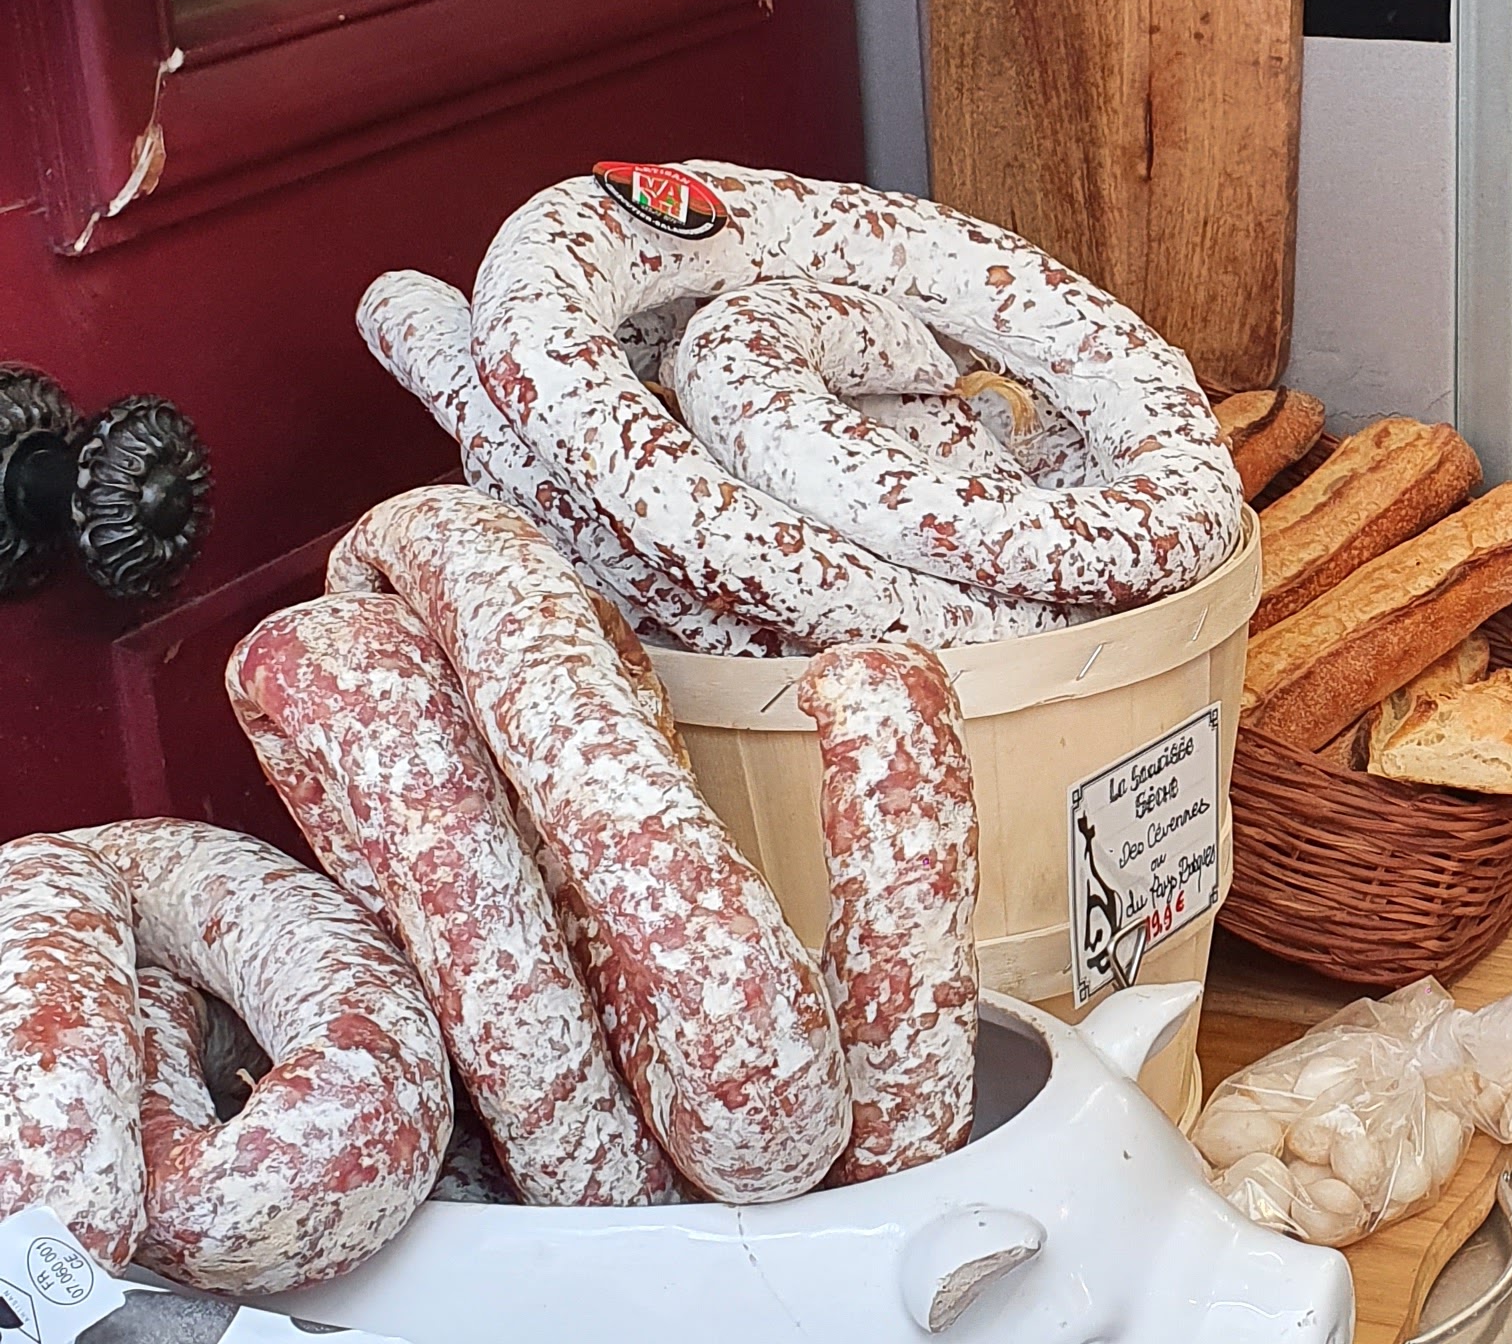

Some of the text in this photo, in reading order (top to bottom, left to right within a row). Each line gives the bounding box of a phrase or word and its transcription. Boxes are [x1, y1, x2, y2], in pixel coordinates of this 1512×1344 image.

[1110, 777, 1128, 804] La
[1119, 798, 1211, 869] Des Cévennes
[1126, 889, 1148, 918] du
[1149, 873, 1178, 909] Pays
[36, 1242, 84, 1299] 07.060.001
[63, 1253, 84, 1269] CE
[37, 1269, 55, 1292] FR
